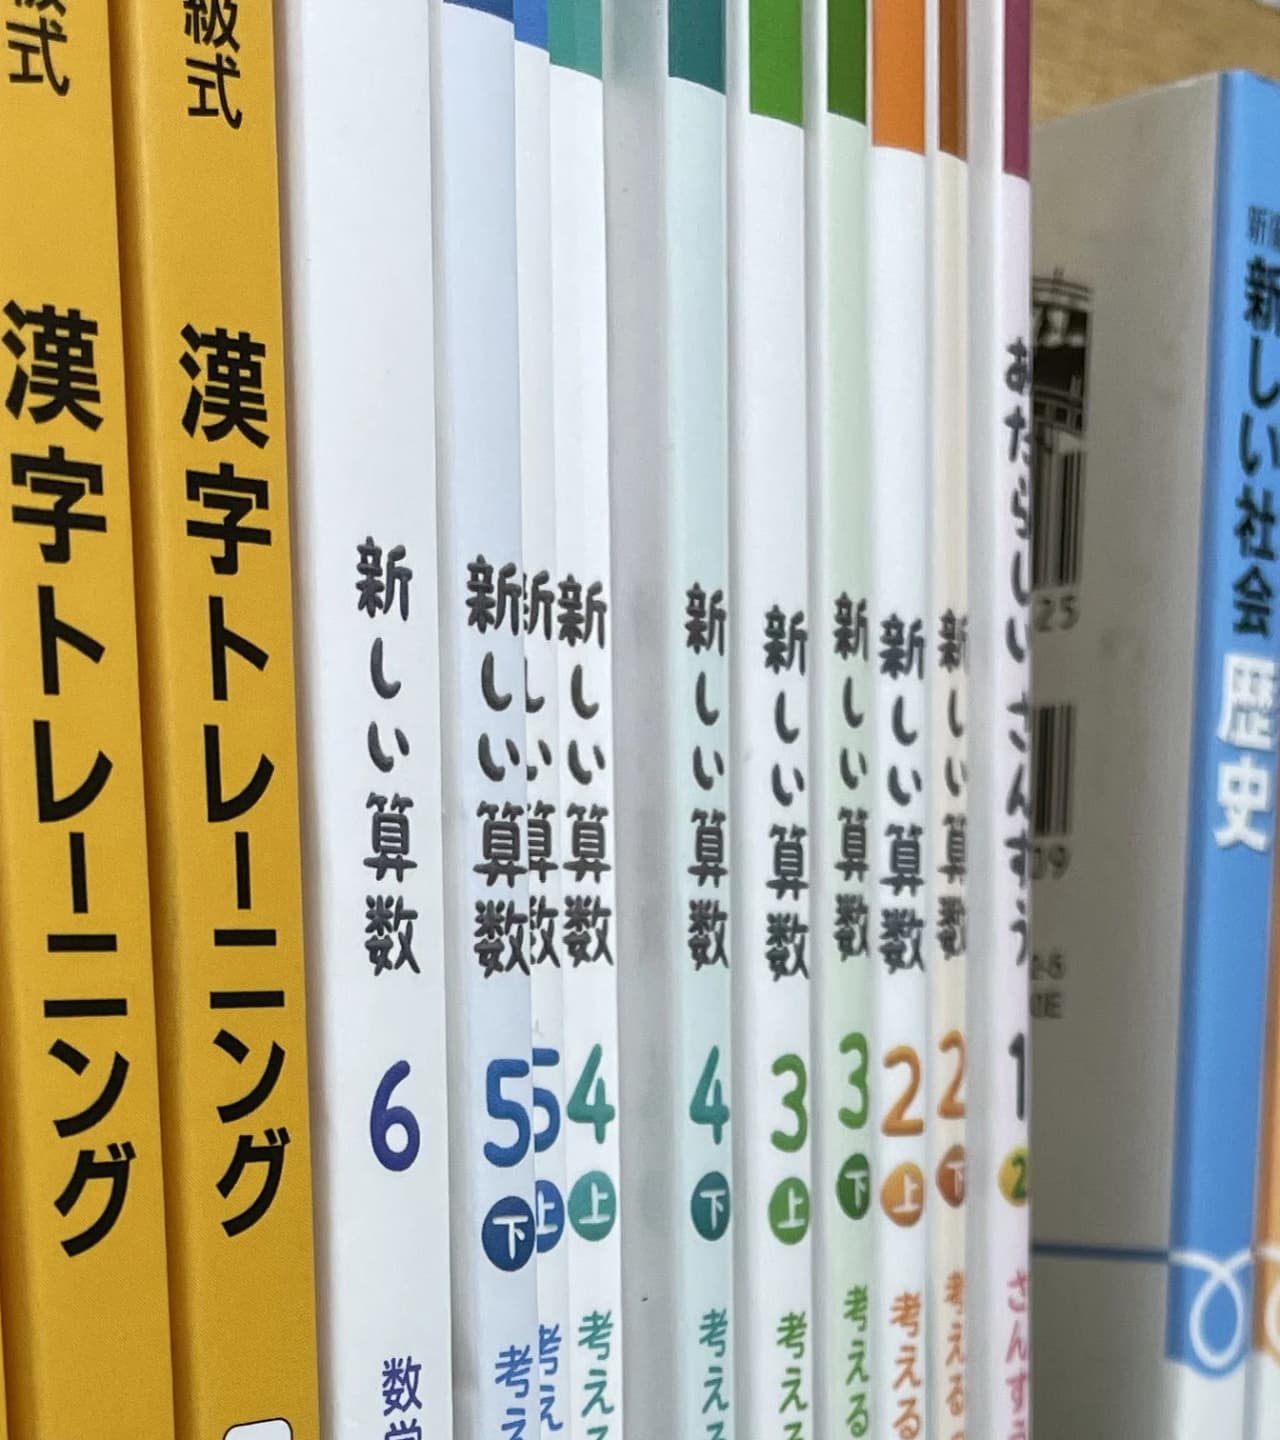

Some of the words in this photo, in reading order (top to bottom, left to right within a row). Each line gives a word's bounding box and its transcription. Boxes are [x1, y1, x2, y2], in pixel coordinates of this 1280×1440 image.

[7, 0, 70, 96] 式
[2, 300, 137, 1258] 漢字トレーニング
[180, 323, 291, 1238] 漢字トレーニング
[356, 536, 420, 976] 新しい算数
[465, 555, 530, 977] 新しい算数
[557, 573, 614, 967] 新しい算数
[685, 581, 730, 971] 新しい算数
[763, 605, 809, 982] 新しい算数
[833, 591, 870, 962] 新しい算数
[879, 612, 924, 974] 新しい算数
[937, 608, 968, 960] 新しい算数
[1214, 653, 1278, 852] 歴史
[370, 1060, 420, 1171] 6
[483, 1058, 531, 1168] 5
[566, 1043, 615, 1144] 4
[689, 1046, 730, 1145] 4
[771, 1053, 808, 1152] 3
[839, 1032, 870, 1129] 3
[882, 1046, 924, 1136] 2
[937, 1029, 965, 1119] 2
